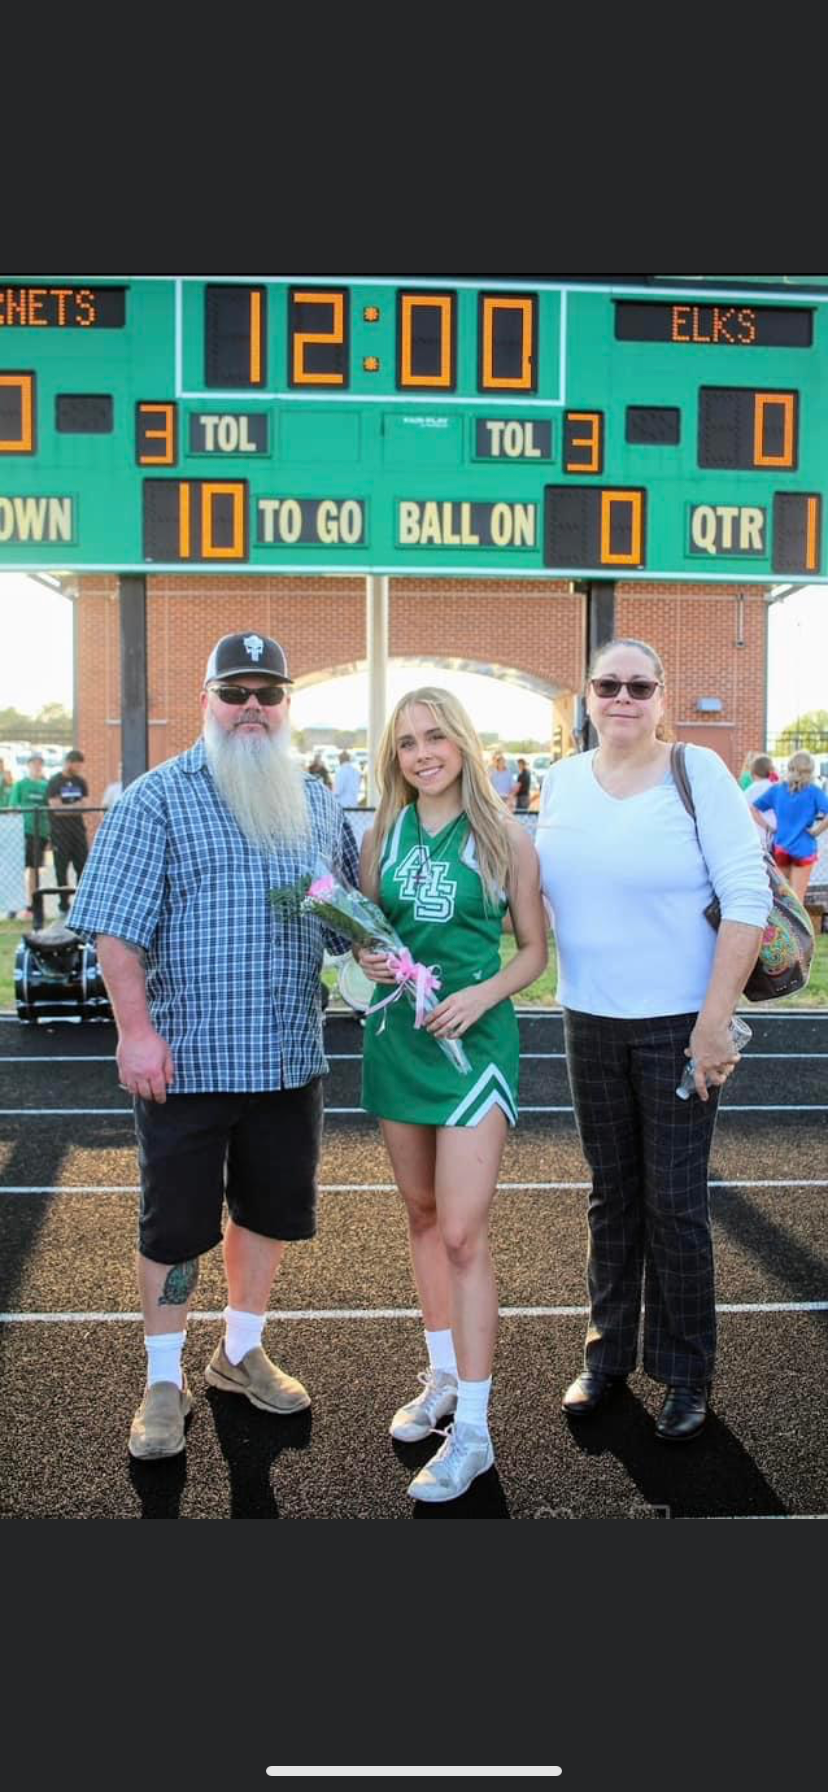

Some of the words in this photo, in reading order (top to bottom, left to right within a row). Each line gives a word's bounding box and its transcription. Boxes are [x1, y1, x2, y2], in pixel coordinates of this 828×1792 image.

[0, 289, 96, 326] NETS
[672, 306, 755, 343] ELKS
[250, 291, 532, 389] 12:00
[140, 405, 173, 464] 3
[200, 416, 256, 452] TOL
[486, 421, 541, 457] TOL
[567, 413, 599, 472] 3
[753, 393, 794, 467] 0
[179, 483, 244, 558] 10
[259, 500, 302, 543] TO
[316, 500, 362, 543] GO
[399, 502, 480, 545] BALL
[490, 504, 535, 546] ON
[601, 491, 642, 565] 0
[692, 506, 764, 554] QTR
[806, 498, 817, 570] 1
[394, 845, 457, 922] AHS
